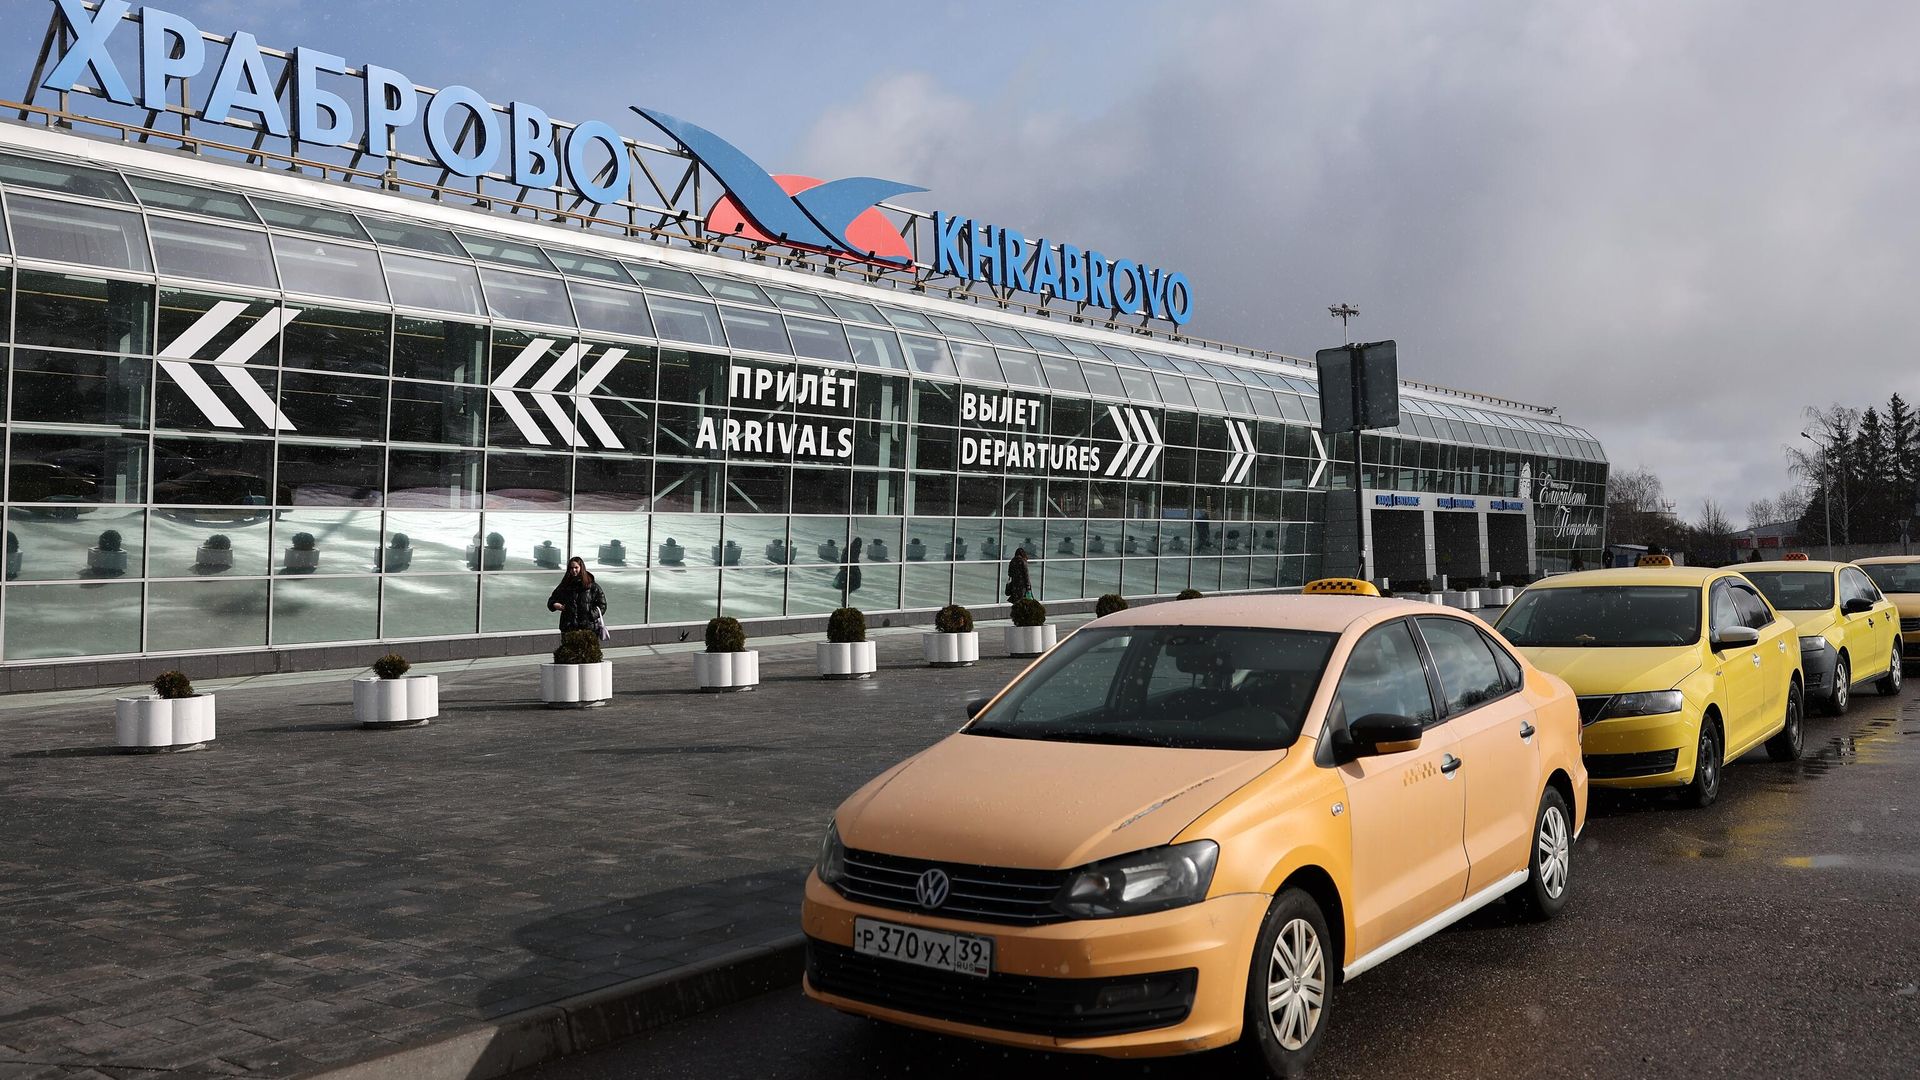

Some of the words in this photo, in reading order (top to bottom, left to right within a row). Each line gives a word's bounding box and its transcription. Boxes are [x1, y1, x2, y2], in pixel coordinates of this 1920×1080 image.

[41, 0, 631, 204] ХРАБРОВО
[933, 210, 1194, 326] KHRABROVO
[730, 365, 856, 409] ПРИЛЁТ
[962, 392, 1041, 426] ВЫЛЕТ
[695, 416, 853, 459] ARRIVALS
[961, 437, 1101, 472] DEPARTURES
[956, 961, 975, 972] RUS
[958, 939, 982, 964] 39
